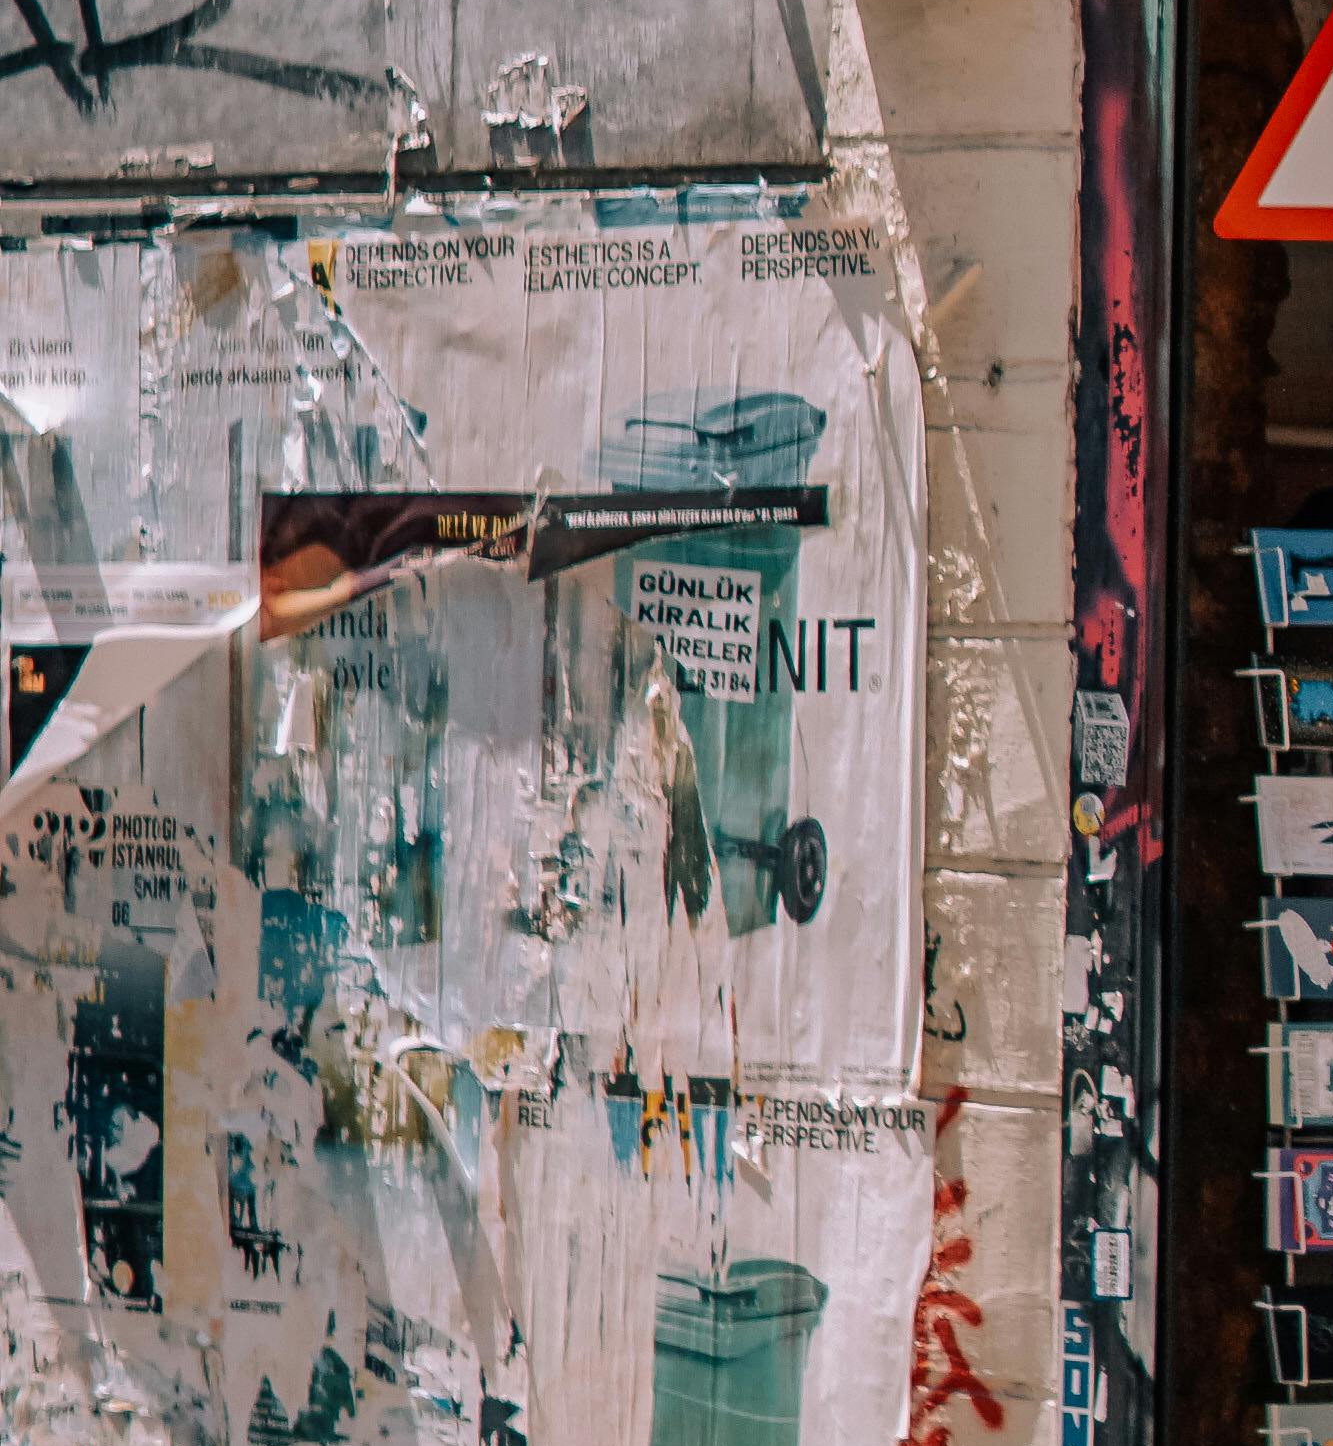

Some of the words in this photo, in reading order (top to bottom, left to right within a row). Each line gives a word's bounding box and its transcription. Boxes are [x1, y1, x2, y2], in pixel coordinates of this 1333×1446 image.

[432, 239, 461, 259] ON
[463, 234, 515, 258] YOUR
[523, 241, 633, 267] ESTHETICS
[637, 240, 655, 261] IS
[659, 239, 671, 261] A
[741, 230, 830, 255] DEPENDS
[834, 229, 857, 251] ON
[523, 267, 603, 293] ELATIVE
[607, 262, 702, 288] CONCEPT.
[741, 253, 876, 281] PERSPECTIVE.
[638, 568, 754, 605] GÜNLÜK
[637, 599, 752, 634] KİRALIK
[870, 1104, 926, 1131] YOUR
